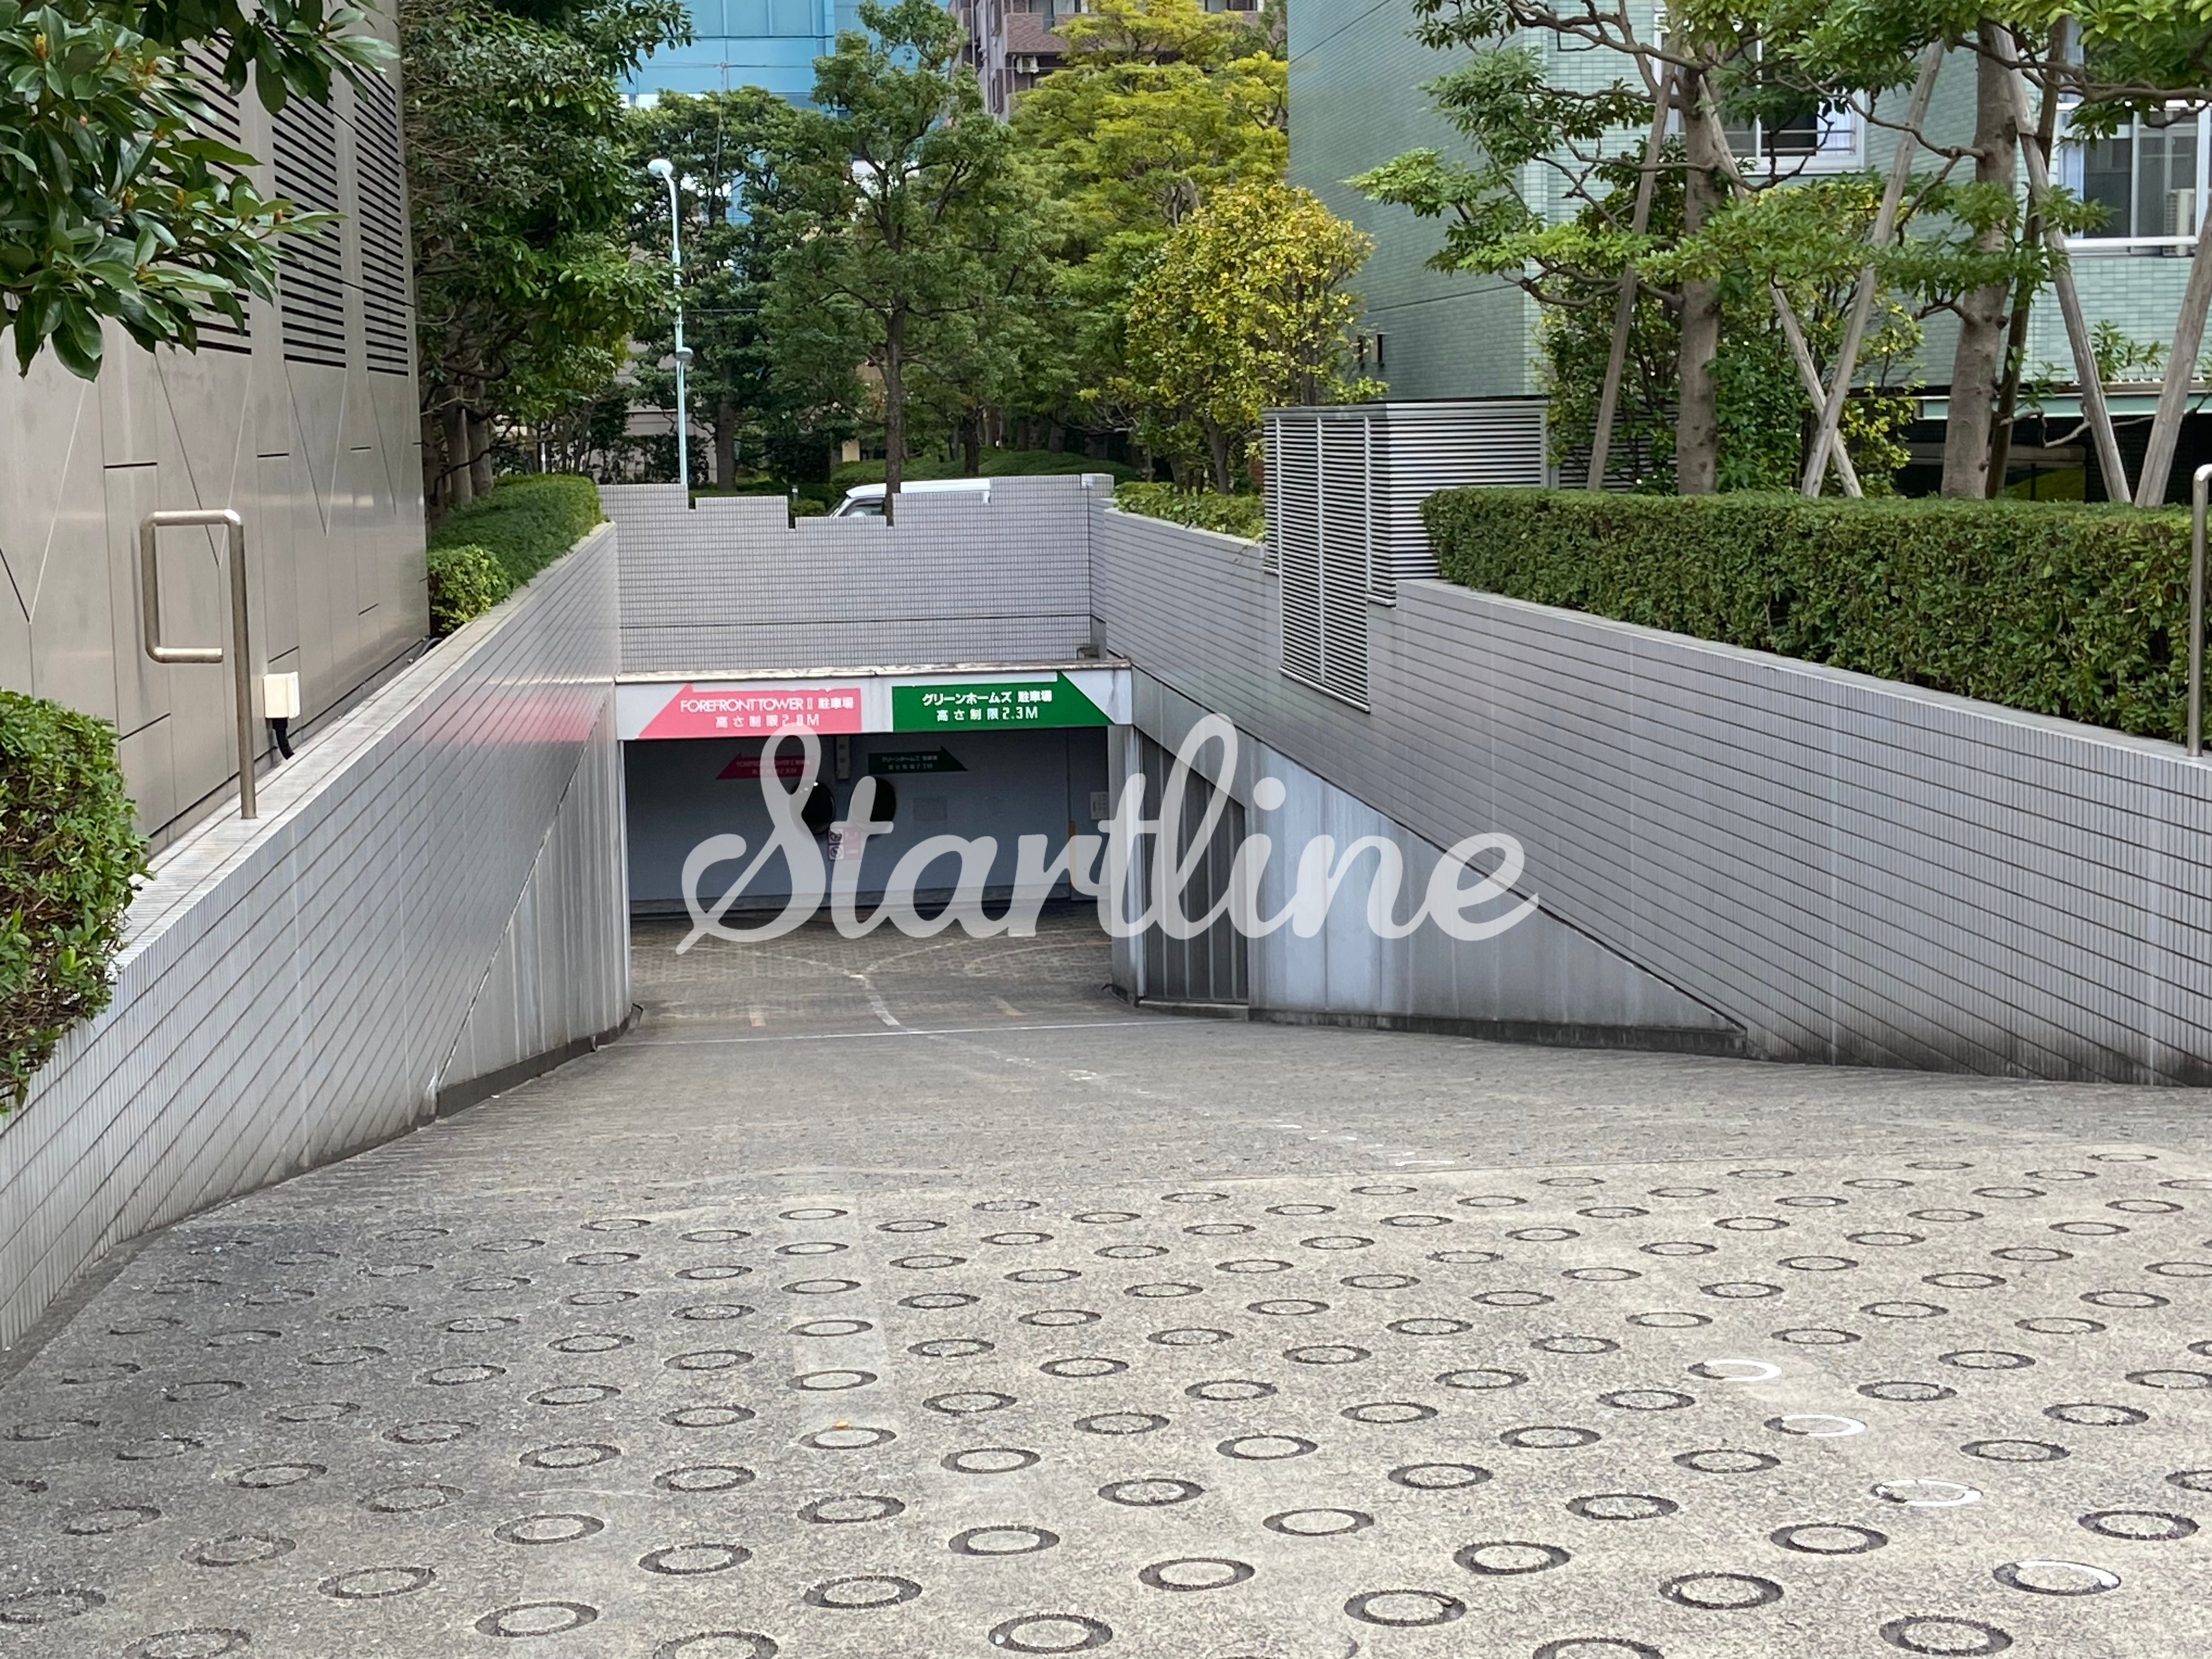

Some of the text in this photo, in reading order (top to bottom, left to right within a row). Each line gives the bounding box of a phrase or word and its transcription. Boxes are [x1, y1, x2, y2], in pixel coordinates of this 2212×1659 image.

[817, 696, 854, 709] 駐車場
[922, 690, 1053, 706] グリーンホームズ 駐車場
